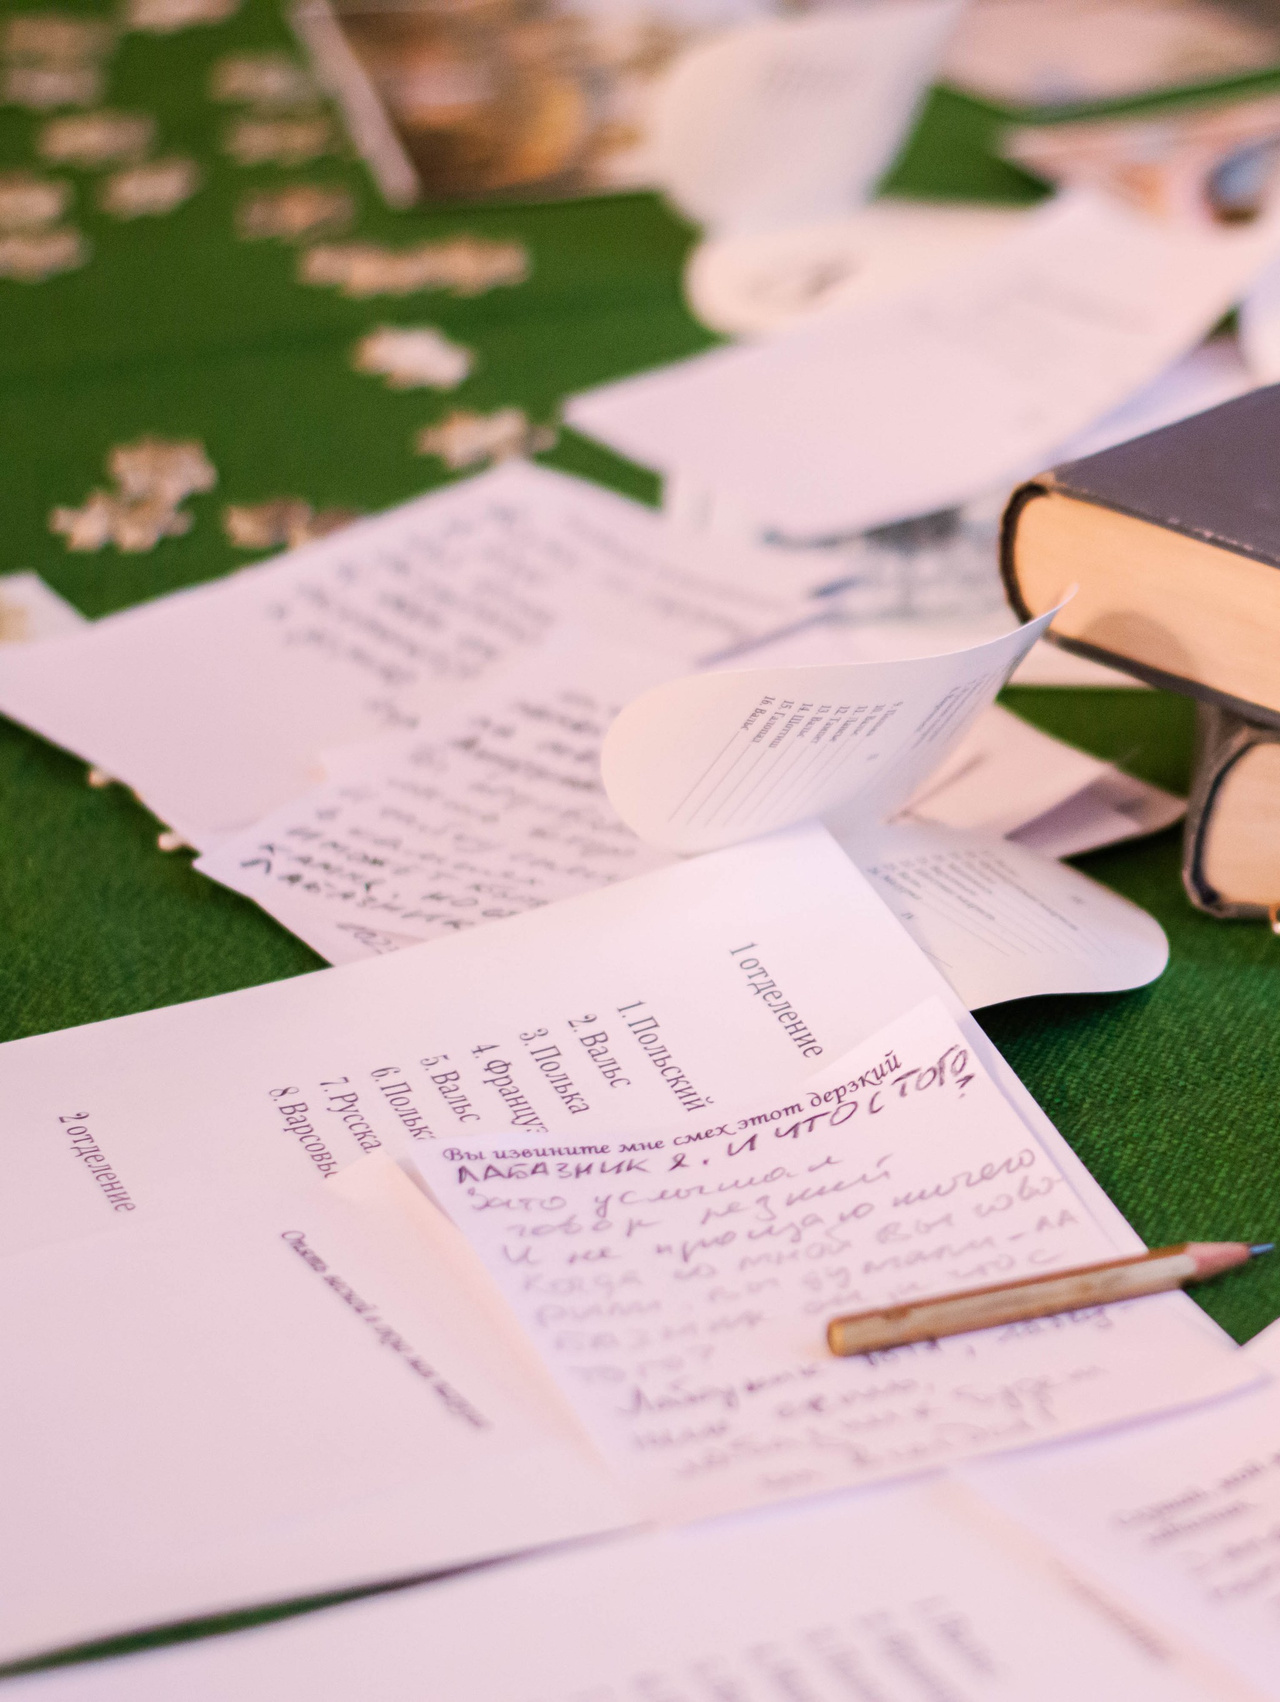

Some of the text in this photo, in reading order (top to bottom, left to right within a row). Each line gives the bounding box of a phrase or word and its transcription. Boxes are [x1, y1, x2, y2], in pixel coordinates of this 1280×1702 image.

[740, 695, 776, 732] 16. Вальс
[778, 700, 795, 711] 15.
[729, 941, 824, 1059] 1 отделение
[319, 1076, 350, 1093] 7.
[471, 1042, 500, 1059] 4.
[518, 1026, 590, 1115] 3. Полька
[567, 1012, 632, 1089] 2. Вальс
[616, 999, 714, 1113] 1. Польский
[268, 1086, 300, 1102] 8.
[370, 1066, 437, 1141] 6. Польк
[419, 1053, 481, 1124] 5. Вальс
[443, 1049, 902, 1162] Вы извините мне смех этот дерзкий
[58, 1111, 136, 1213] 2 отделение
[457, 1157, 651, 1185] ЛАБАЗНИК
[726, 1133, 759, 1157] И
[501, 1244, 543, 1267] И
[566, 1245, 624, 1266] не
[891, 1147, 1036, 1209] ничего
[506, 1213, 662, 1238] говор
